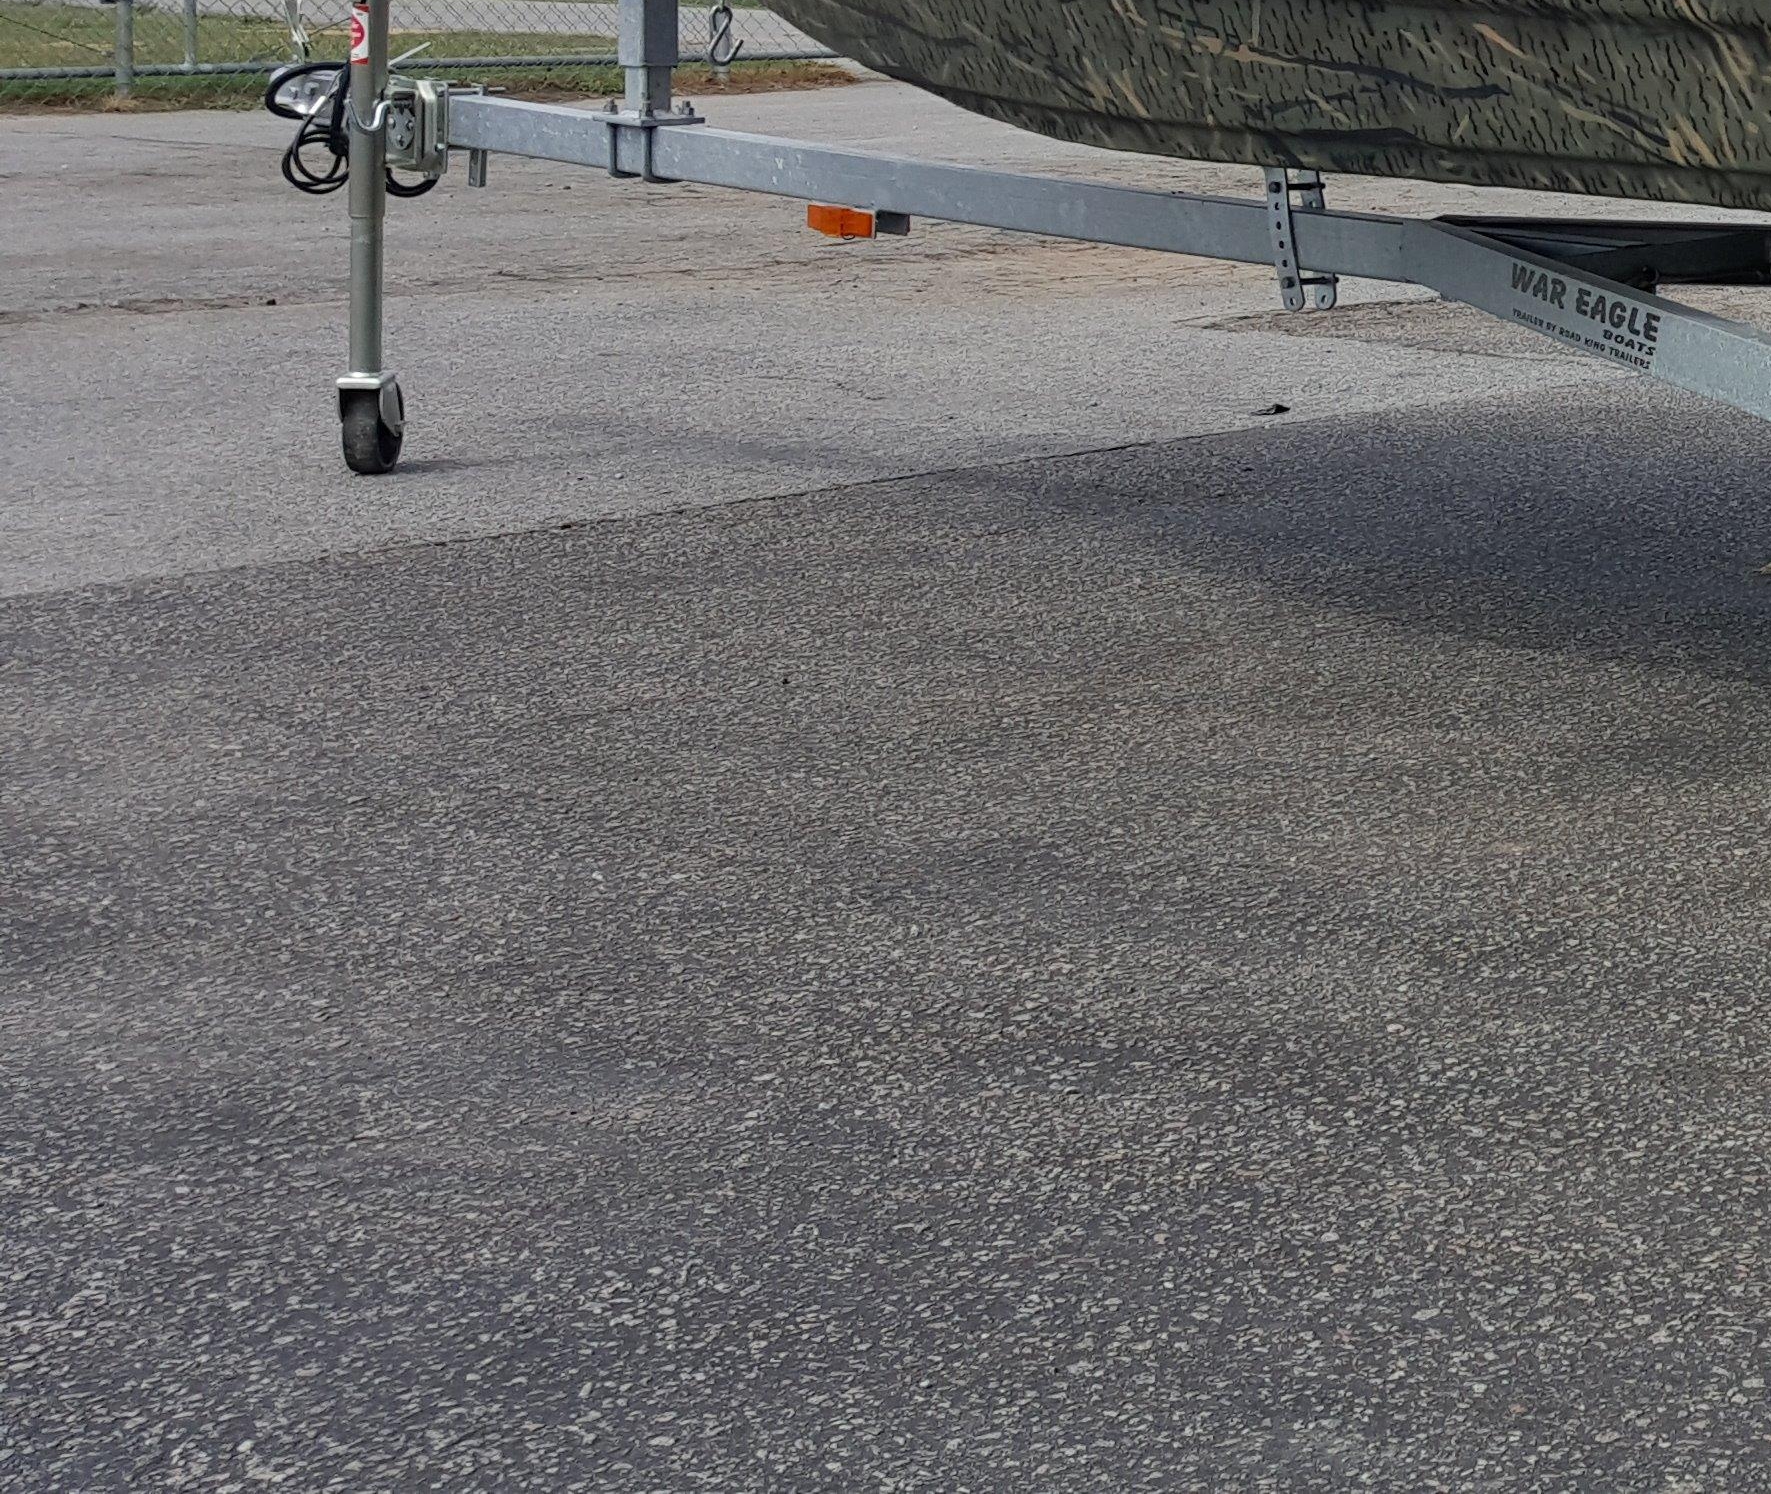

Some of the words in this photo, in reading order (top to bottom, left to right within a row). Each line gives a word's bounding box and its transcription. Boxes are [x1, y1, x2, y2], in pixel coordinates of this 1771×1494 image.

[1511, 263, 1567, 310] WAR
[1576, 288, 1661, 343] EAGLE
[1512, 308, 1544, 328] TRAILER
[1559, 327, 1581, 342] ROAD
[1609, 346, 1651, 369] TRAILERS
[1602, 329, 1656, 356] BOATS
